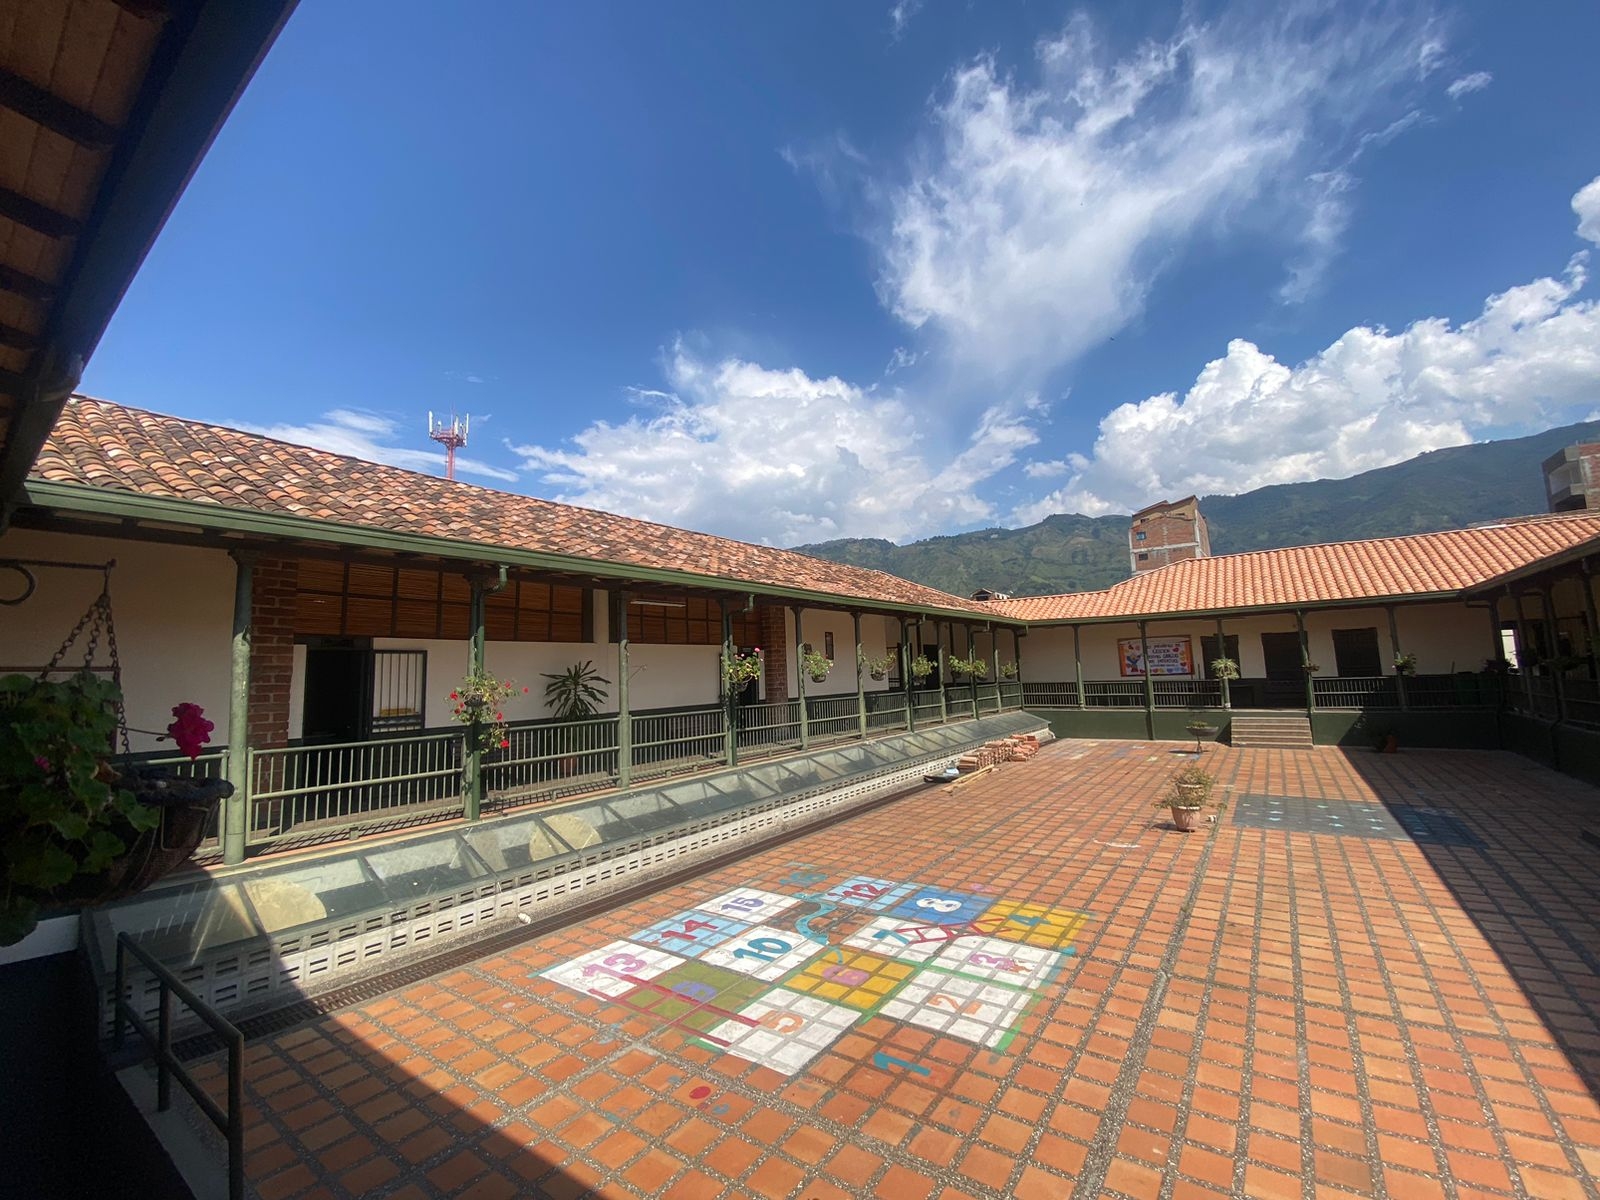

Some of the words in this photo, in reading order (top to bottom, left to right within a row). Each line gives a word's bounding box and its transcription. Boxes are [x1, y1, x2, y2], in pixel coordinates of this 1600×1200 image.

[843, 884, 890, 900] 12
[721, 897, 765, 914] 15
[915, 897, 962, 913] 8
[1008, 914, 1051, 927] 4
[661, 919, 719, 940] 14
[872, 929, 911, 945] 7
[733, 937, 792, 962] 10
[581, 953, 648, 979] 13
[872, 1051, 930, 1076] 1
